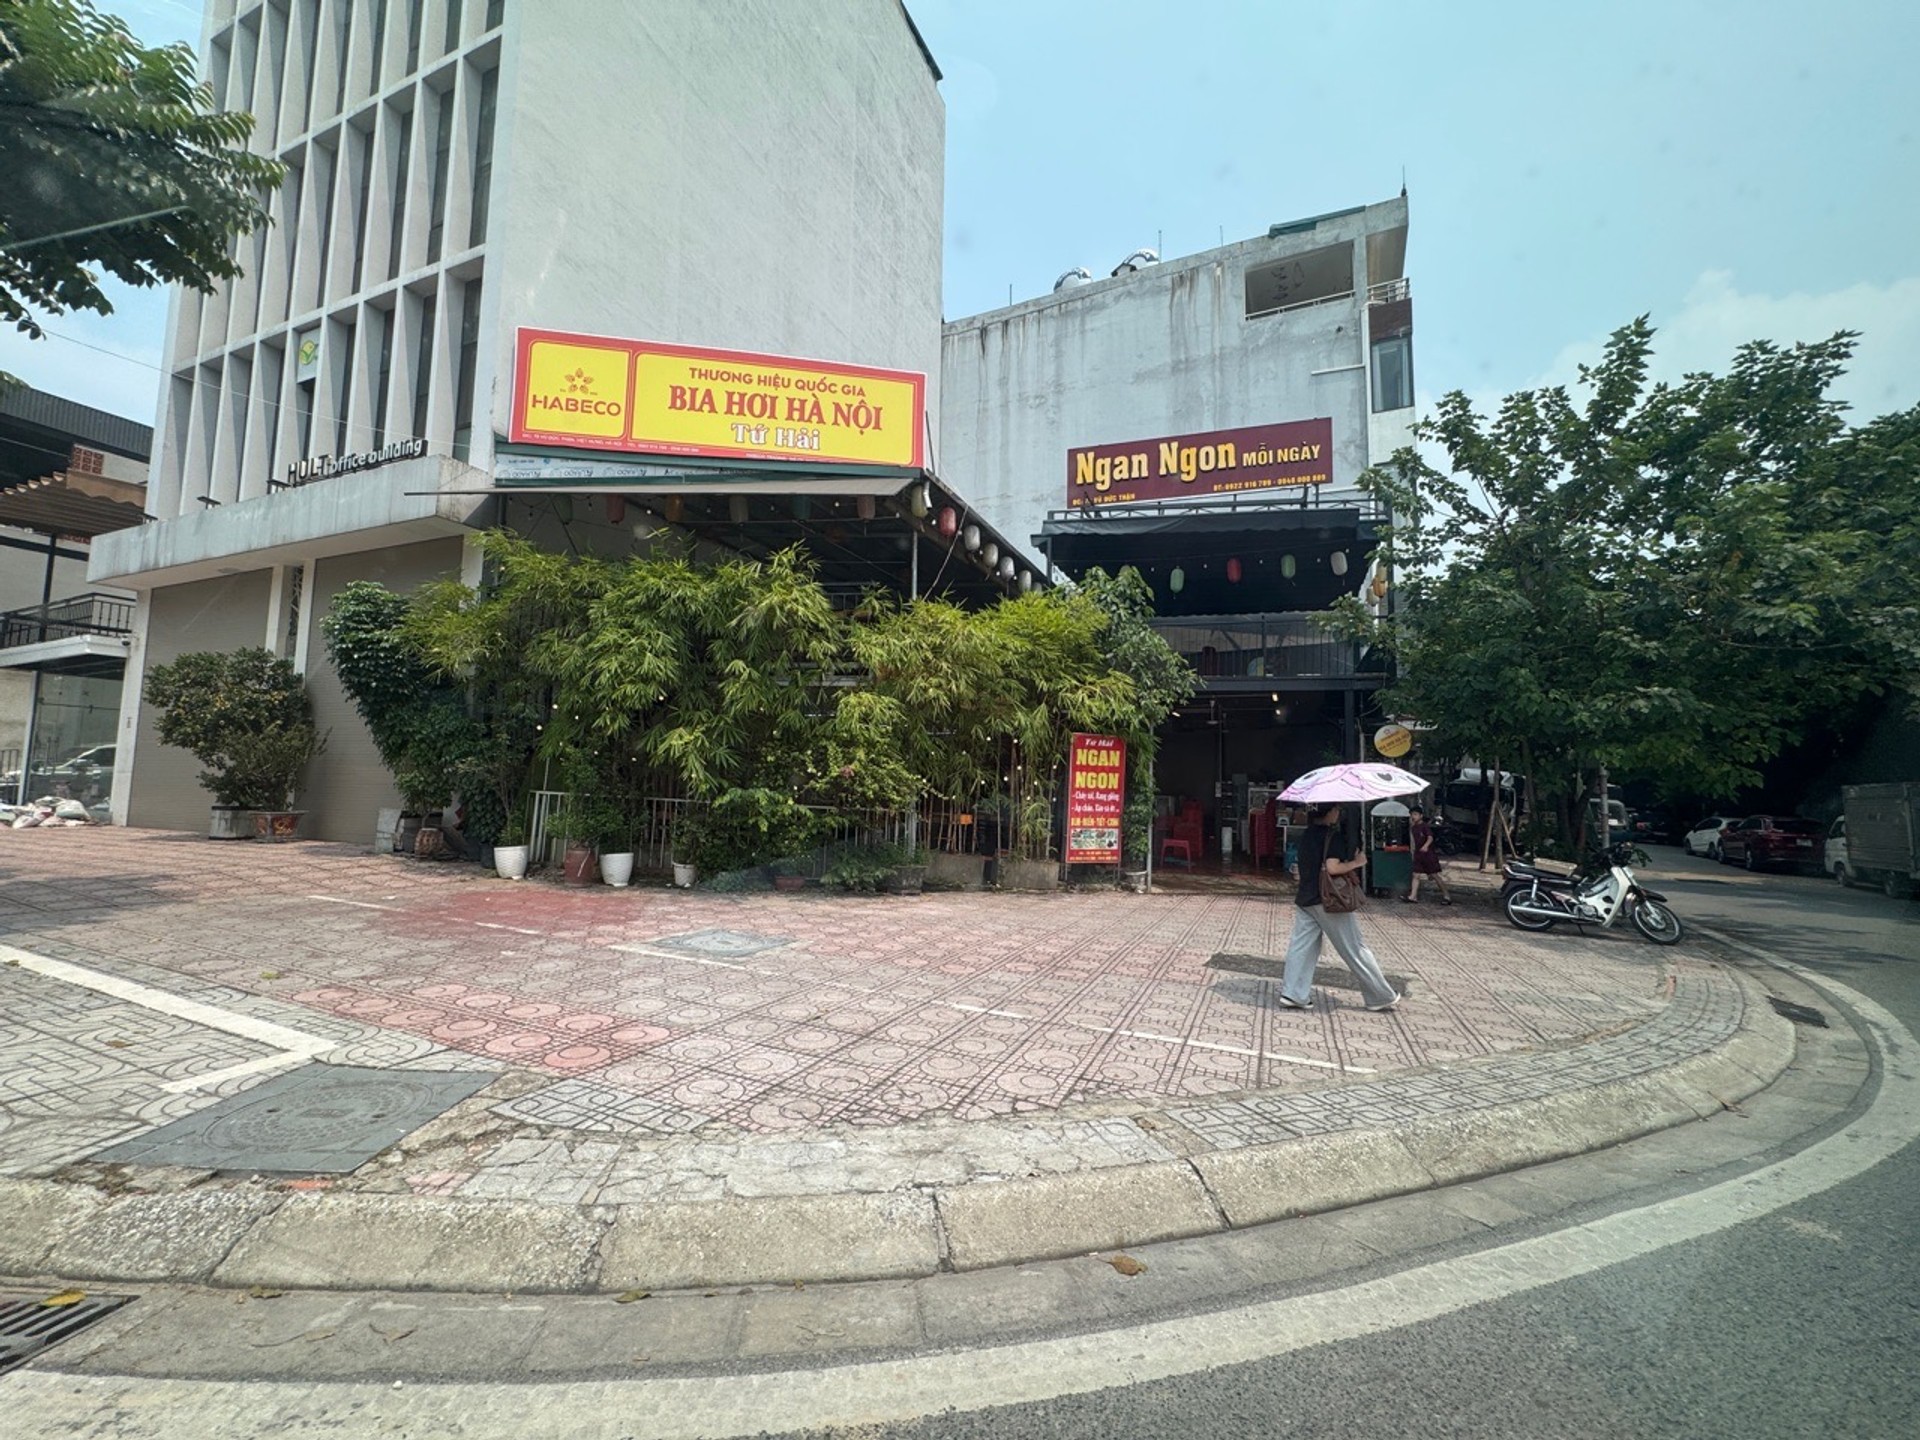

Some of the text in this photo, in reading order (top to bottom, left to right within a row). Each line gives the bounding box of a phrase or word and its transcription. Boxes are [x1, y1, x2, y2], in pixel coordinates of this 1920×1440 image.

[689, 367, 866, 398] THƯƠNG HIỆU QUỐC GIA
[531, 394, 622, 417] HABECO
[668, 385, 882, 436] BIA HƠI HÀ NỘI
[775, 427, 821, 451] Hải
[329, 453, 366, 474] office
[368, 439, 422, 463] building
[1076, 451, 1149, 491] Ngan
[1159, 441, 1237, 482] Ngon
[1277, 441, 1322, 463] NGÀY
[1076, 748, 1120, 767] NGAN
[1075, 771, 1120, 790] NGON
